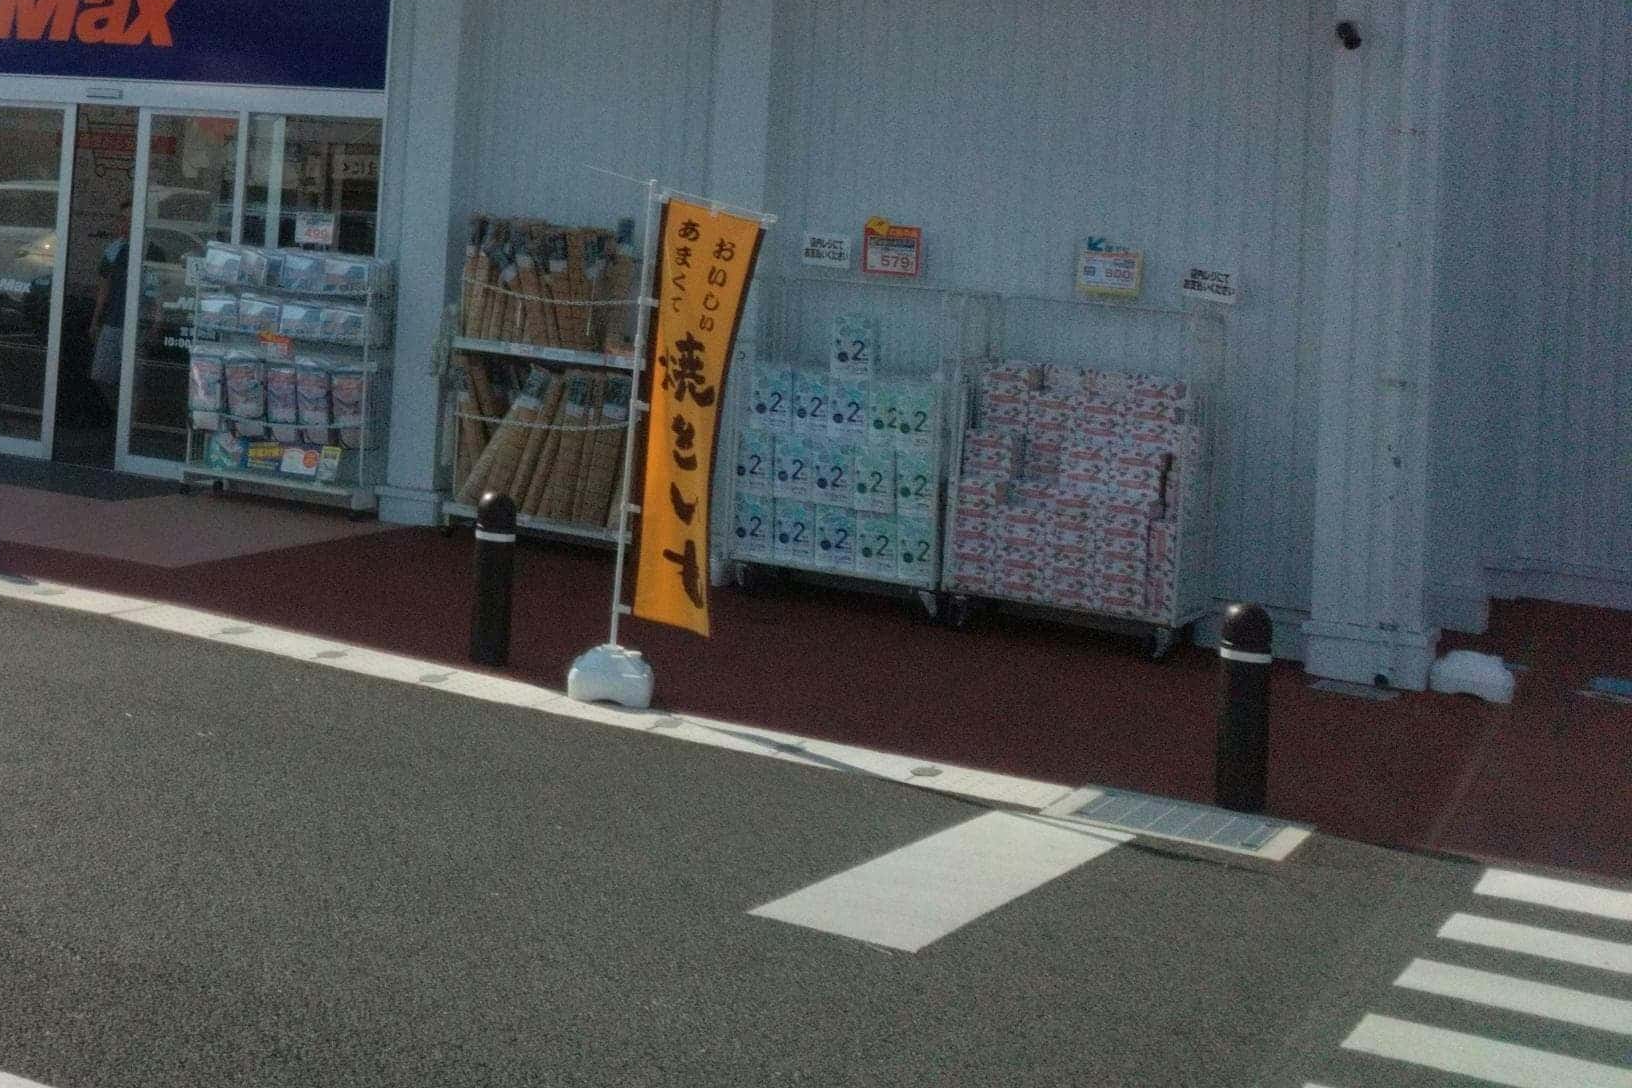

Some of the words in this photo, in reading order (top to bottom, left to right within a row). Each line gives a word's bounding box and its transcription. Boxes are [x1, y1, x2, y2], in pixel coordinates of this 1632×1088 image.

[670, 218, 700, 313] あまくて
[698, 237, 736, 333] おいしい
[658, 331, 716, 610] 焼きいも
